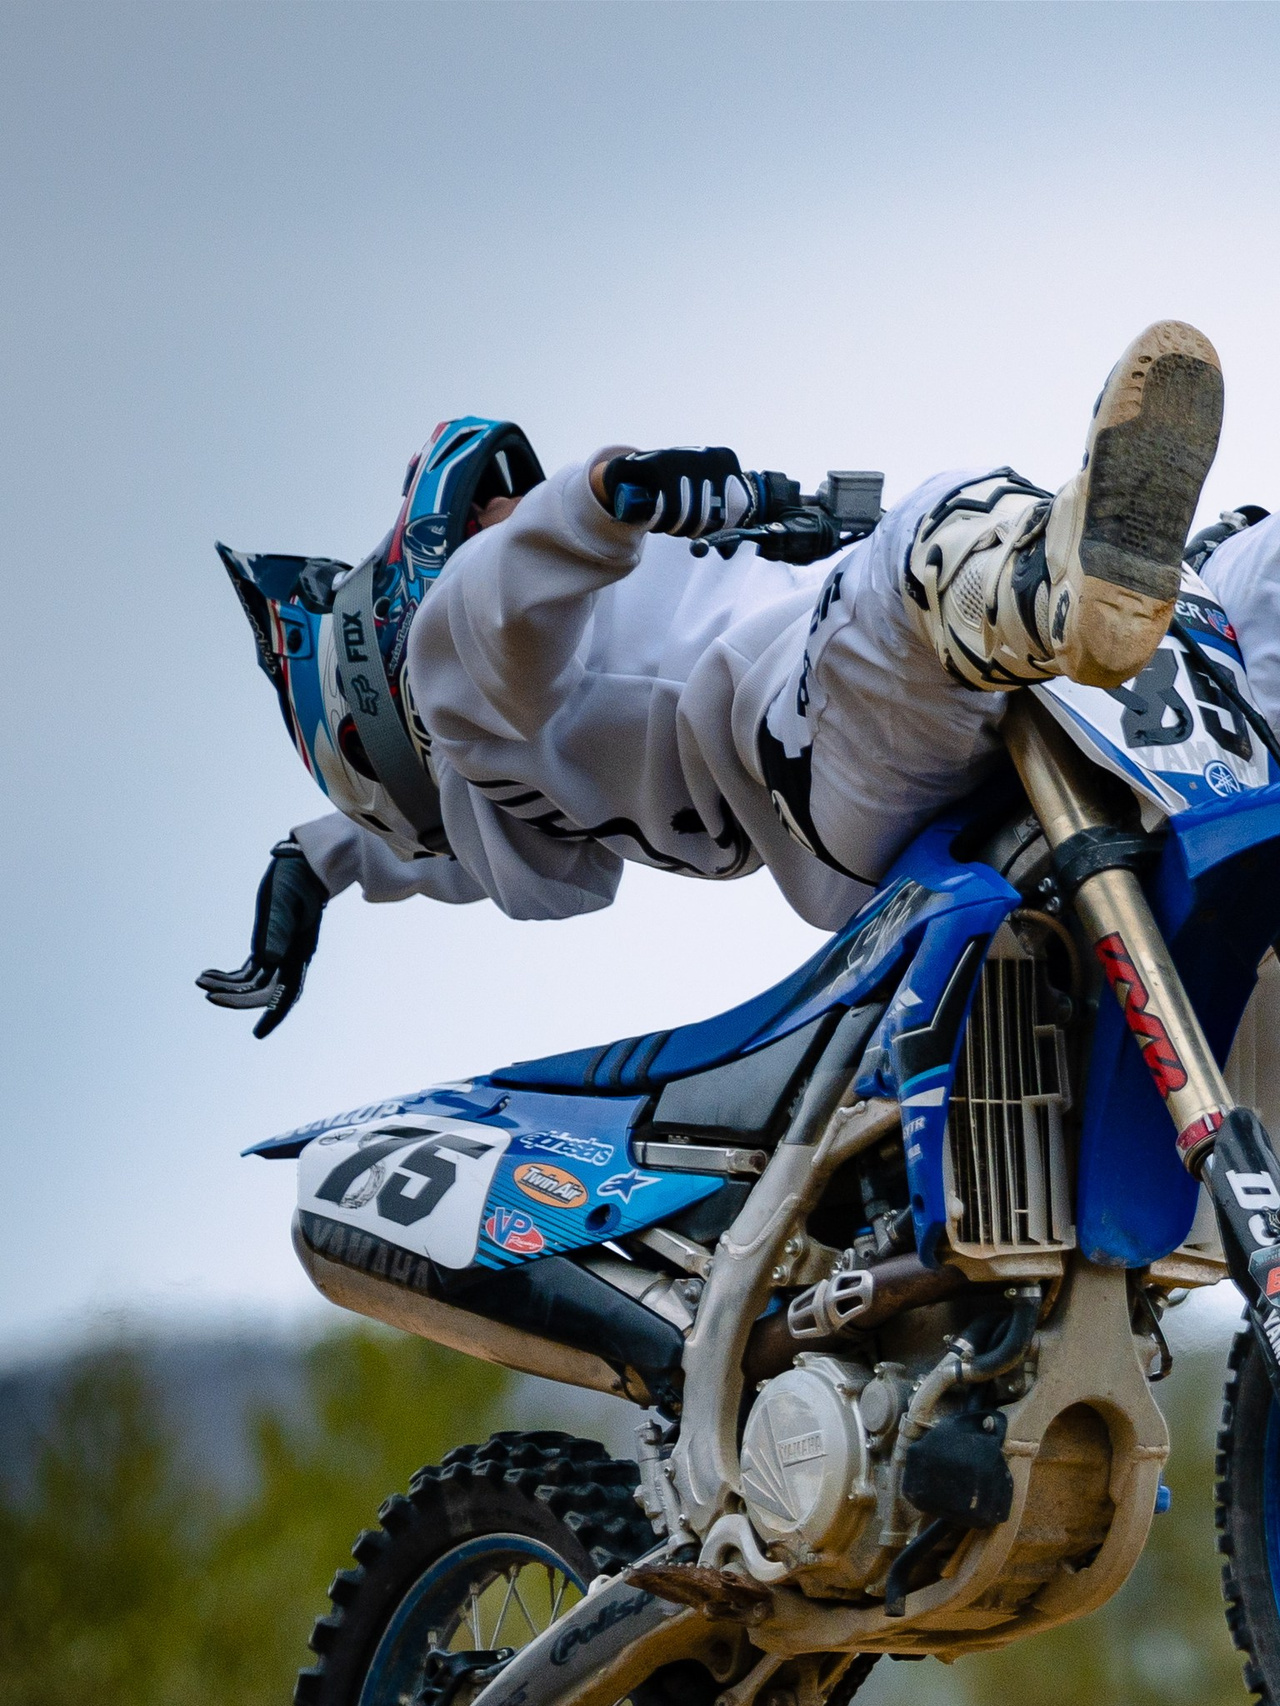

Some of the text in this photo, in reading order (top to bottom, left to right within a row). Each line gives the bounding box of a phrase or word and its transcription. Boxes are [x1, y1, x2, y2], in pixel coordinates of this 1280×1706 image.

[342, 610, 368, 663] FOX
[520, 1166, 583, 1202] Twin Air
[495, 1206, 534, 1249] VP
[311, 1218, 430, 1295] YAMAHA
[778, 1435, 822, 1461] YAMAHA
